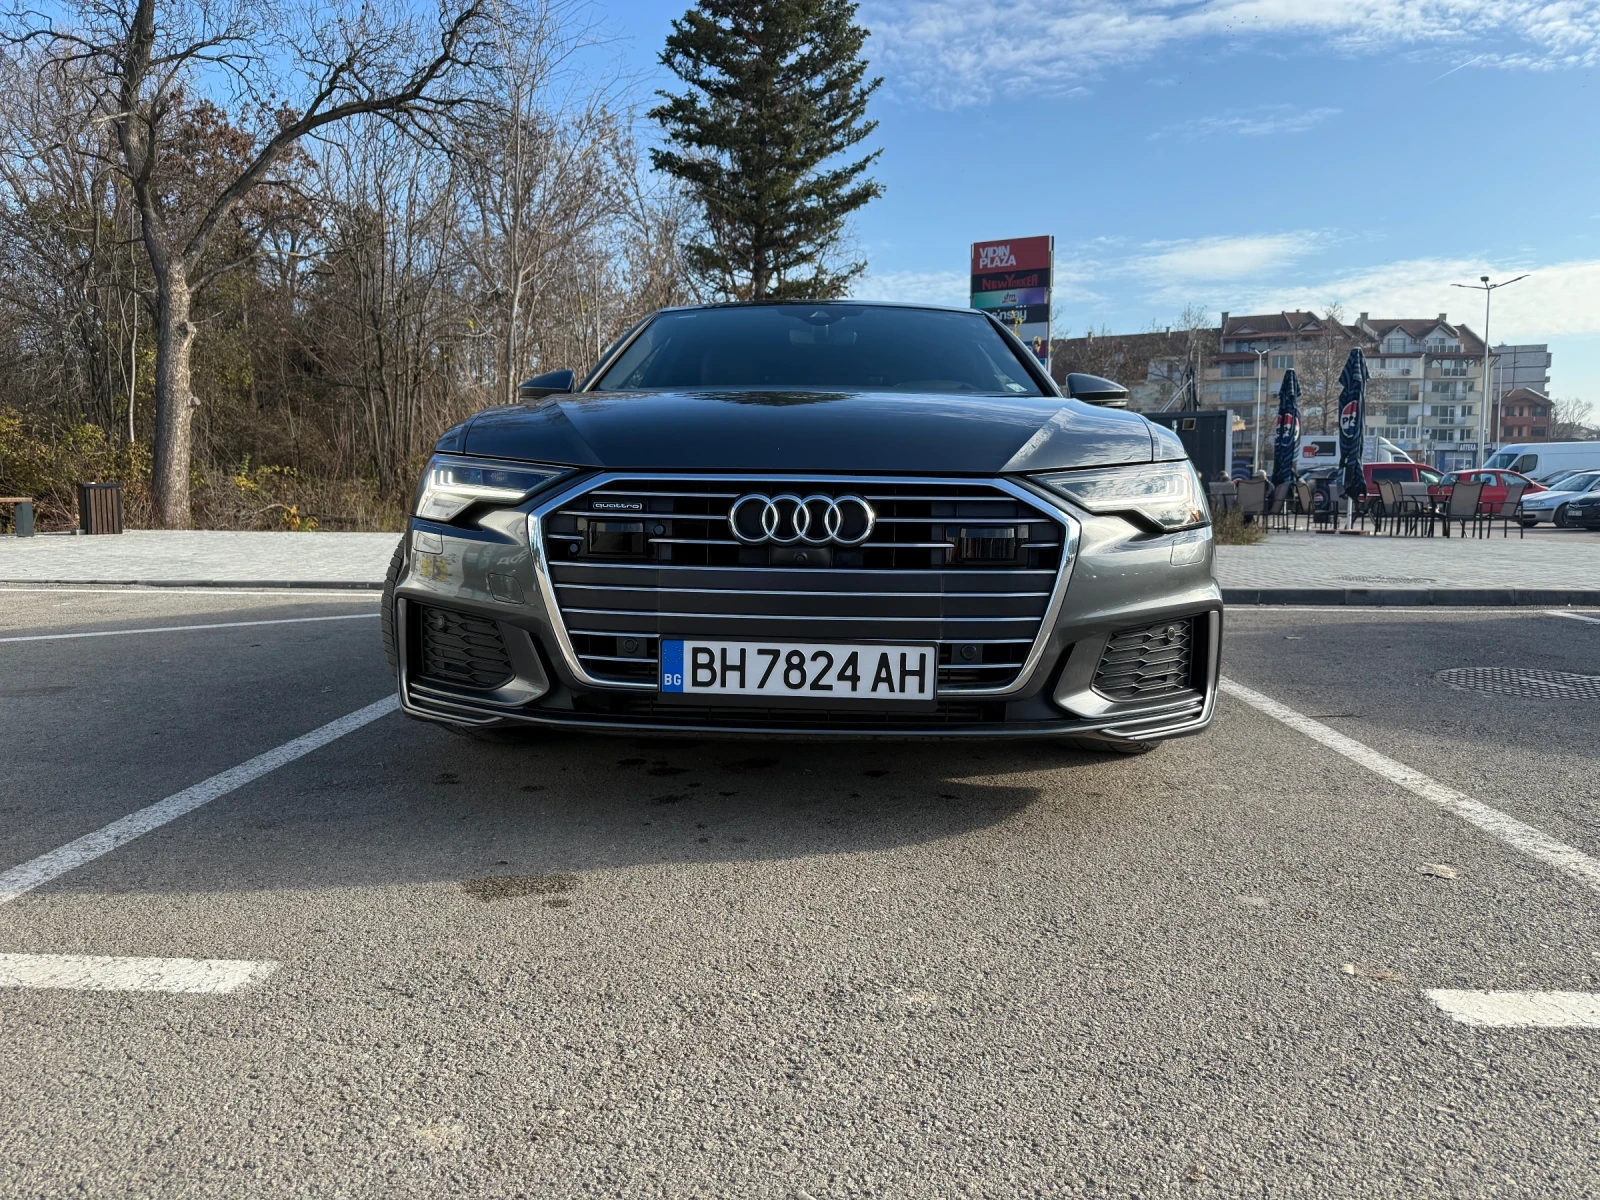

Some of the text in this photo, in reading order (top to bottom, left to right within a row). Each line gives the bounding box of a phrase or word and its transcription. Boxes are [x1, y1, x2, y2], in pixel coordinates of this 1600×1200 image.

[979, 245, 1010, 258] VIDIN
[979, 255, 1016, 269] PLAZA
[1004, 292, 1016, 300] dm
[595, 502, 641, 510] quattro
[691, 646, 926, 694] BH 7824 AH
[664, 673, 682, 686] BG
